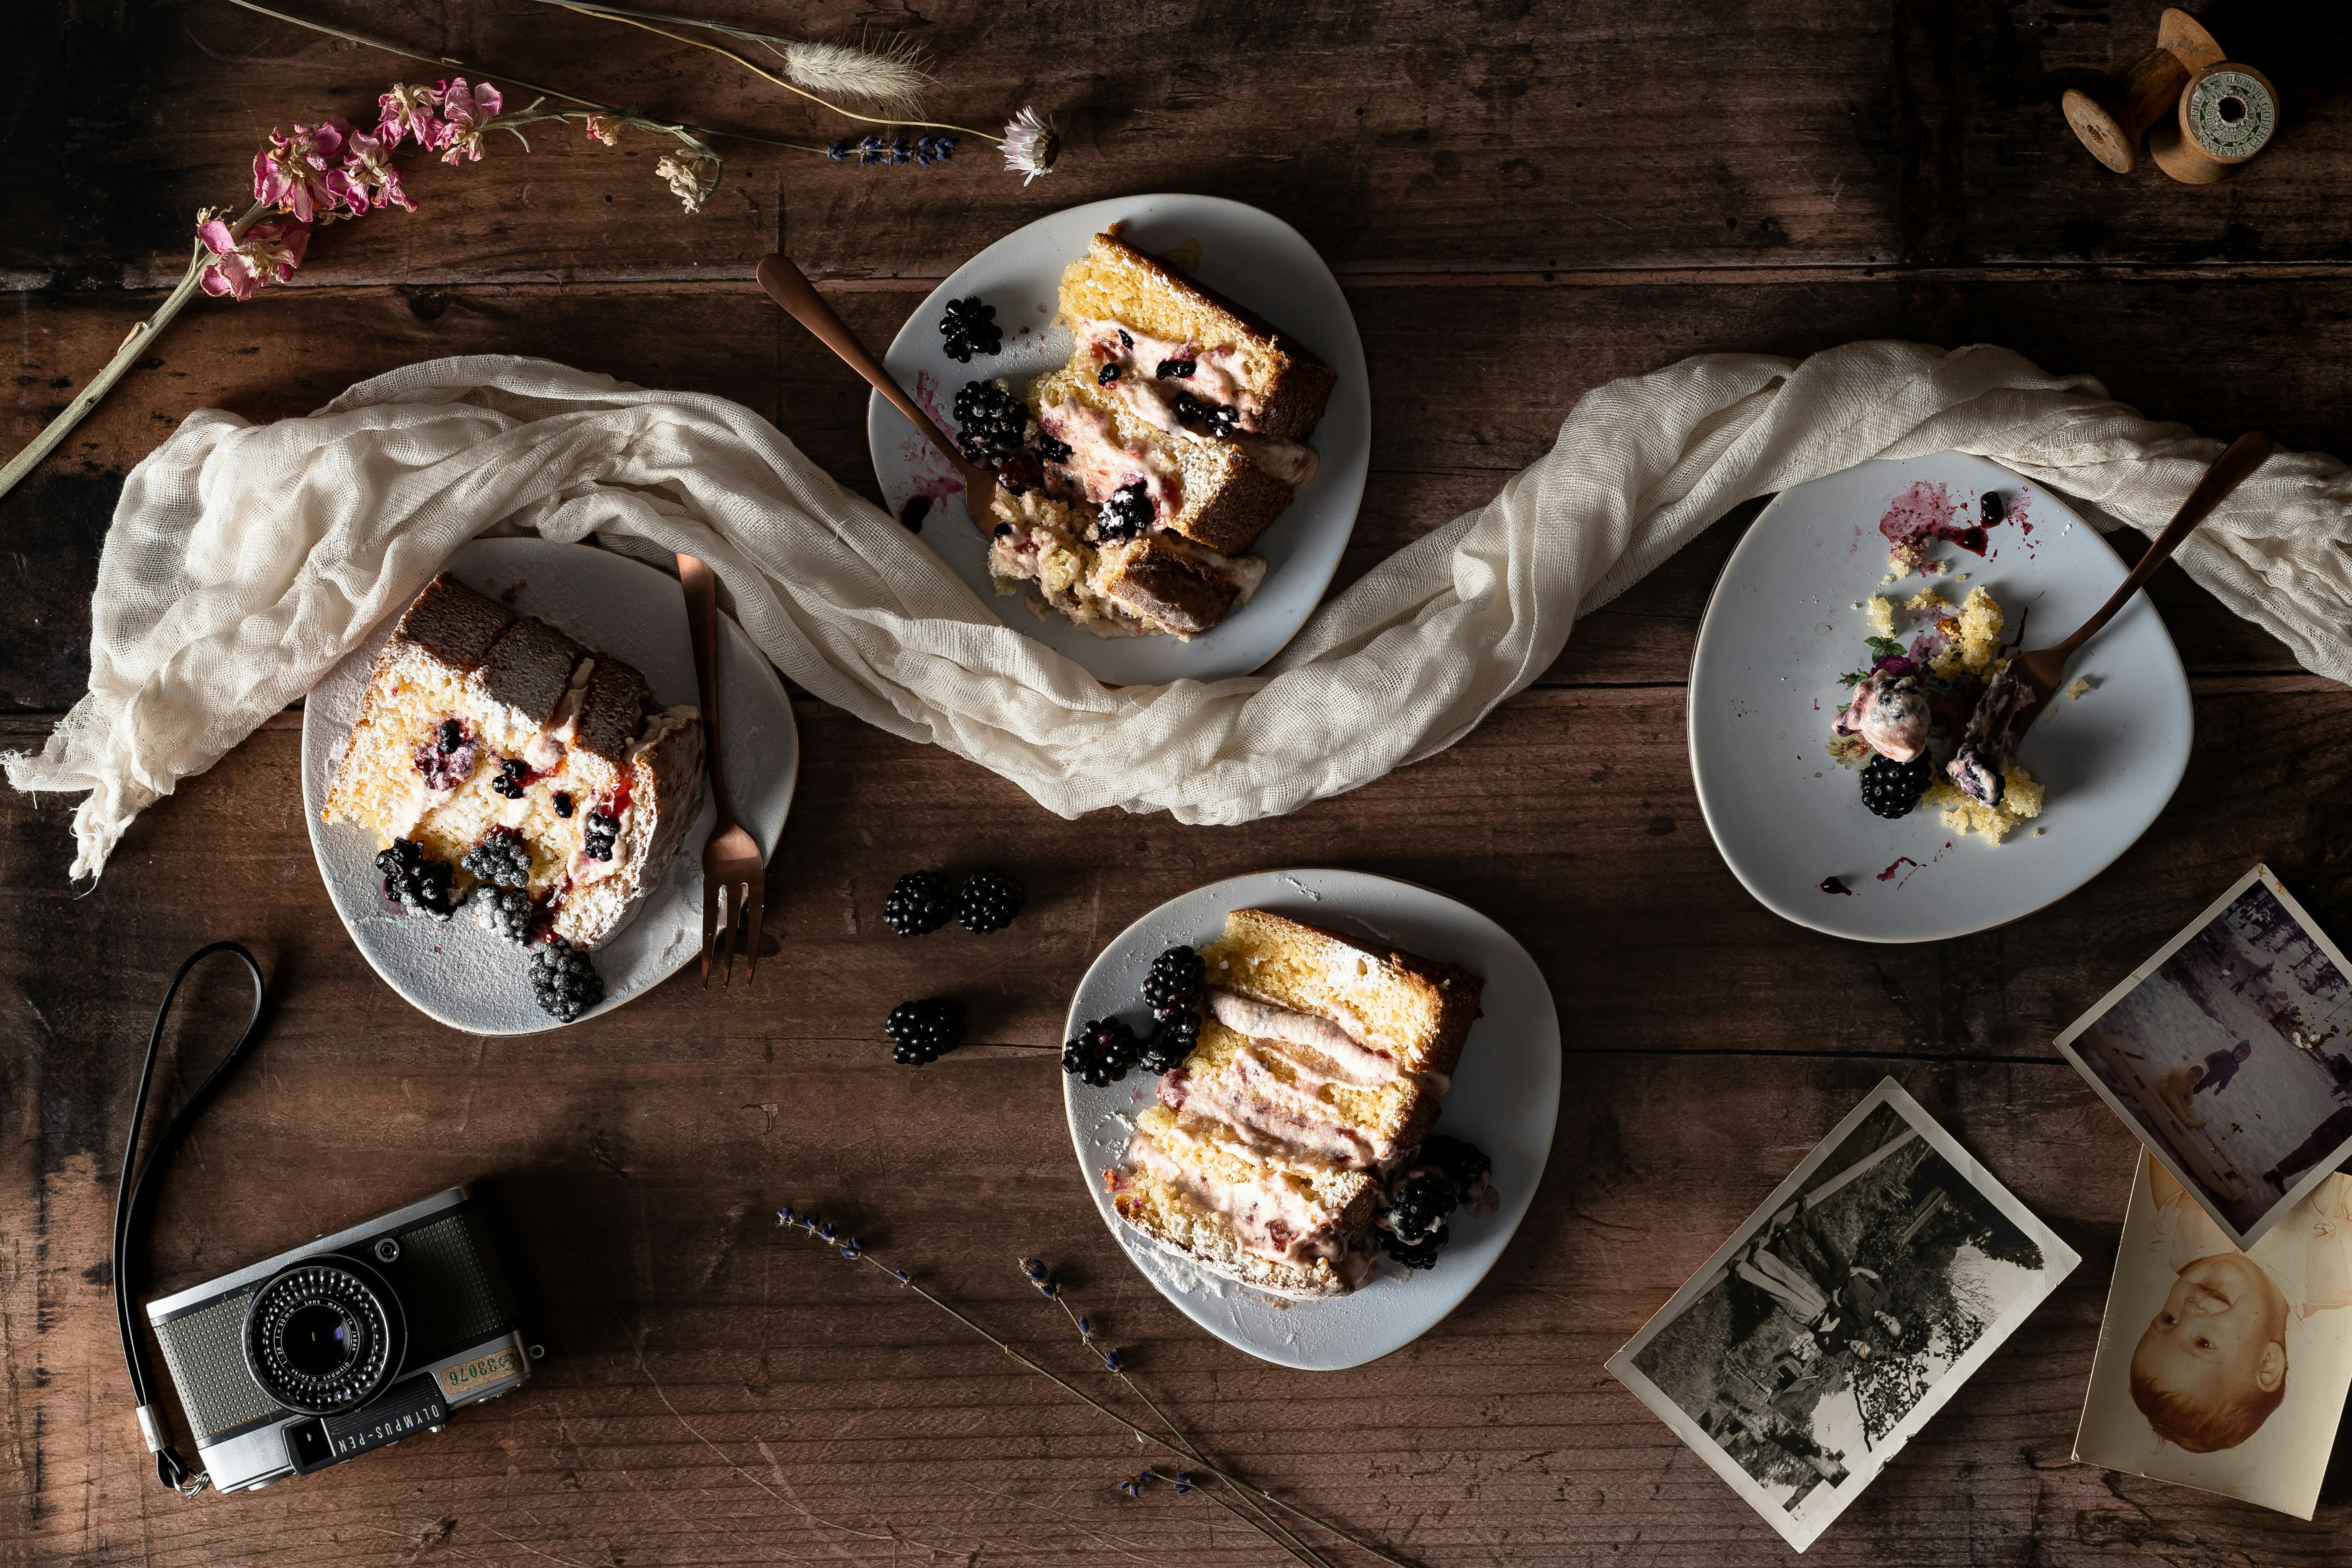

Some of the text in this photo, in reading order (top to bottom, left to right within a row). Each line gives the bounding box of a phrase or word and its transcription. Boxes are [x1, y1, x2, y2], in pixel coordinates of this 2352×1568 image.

[2227, 76, 2265, 100] DIAMOND
[2206, 104, 2218, 134] 200 ELLEN
[2219, 113, 2254, 140] EXTRA QUALITY
[2249, 103, 2271, 152] GODFREY
[328, 1302, 344, 1314] made
[323, 1362, 349, 1380] Olympus
[449, 1358, 497, 1386] 33076
[338, 1405, 439, 1453] OLYMPUS-PEN
